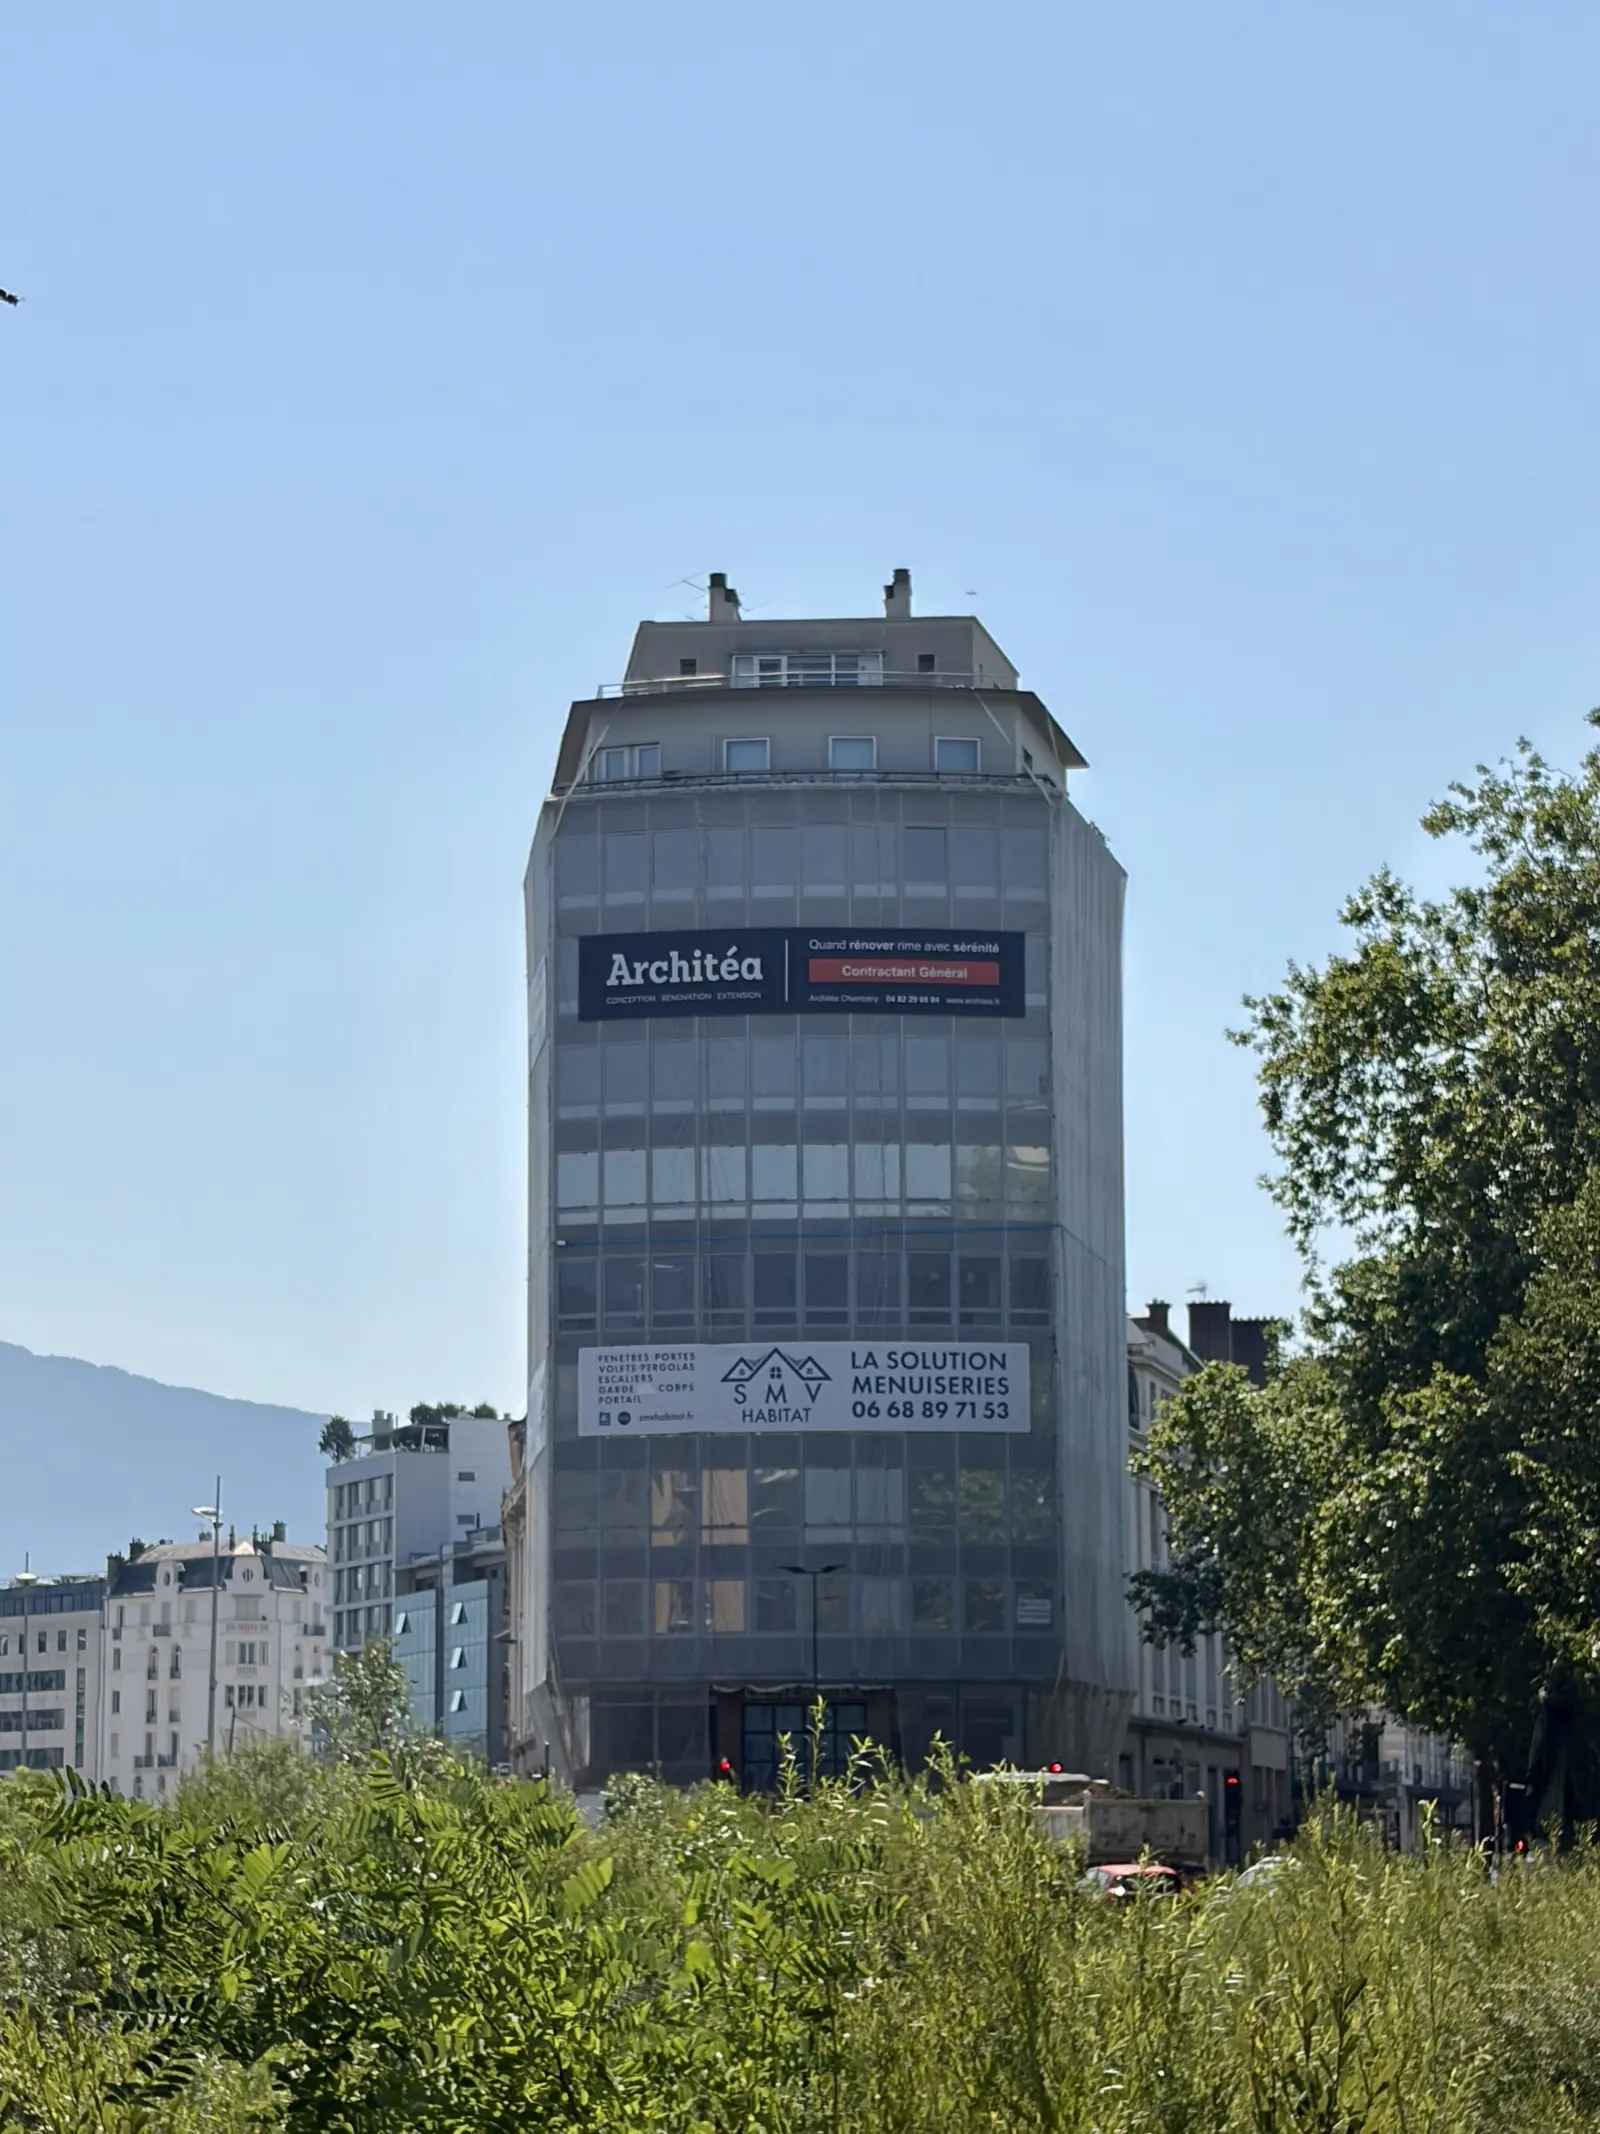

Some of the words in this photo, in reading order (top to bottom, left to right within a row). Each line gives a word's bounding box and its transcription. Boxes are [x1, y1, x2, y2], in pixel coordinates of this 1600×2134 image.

[809, 939, 847, 950] Quand
[850, 939, 895, 951] rénover
[897, 941, 922, 951] rime
[924, 943, 950, 952] avec
[953, 942, 1000, 953] sérénité
[606, 945, 763, 986] Architéa
[842, 965, 916, 977] Contractant
[919, 966, 968, 979] Général
[606, 995, 656, 1004] CONCEPTION
[717, 991, 762, 1000] EXTENSION
[655, 1352, 696, 1361] PORTES
[851, 1351, 879, 1369] LA
[887, 1351, 1006, 1370] SOLUTION
[598, 1364, 637, 1373] VOLETS
[640, 1363, 695, 1372] PERGOLAS
[598, 1374, 653, 1384] ESCALIERS
[852, 1376, 1009, 1395] MENUISERIES
[598, 1385, 634, 1394] GARDE
[658, 1383, 694, 1392] CORPS
[598, 1395, 642, 1404] PORTAIL
[742, 1408, 811, 1423] HABITAT
[852, 1401, 881, 1418] 06
[887, 1401, 914, 1418] 68
[922, 1401, 949, 1419] 89
[955, 1402, 976, 1418] 71
[983, 1402, 1009, 1419] 53
